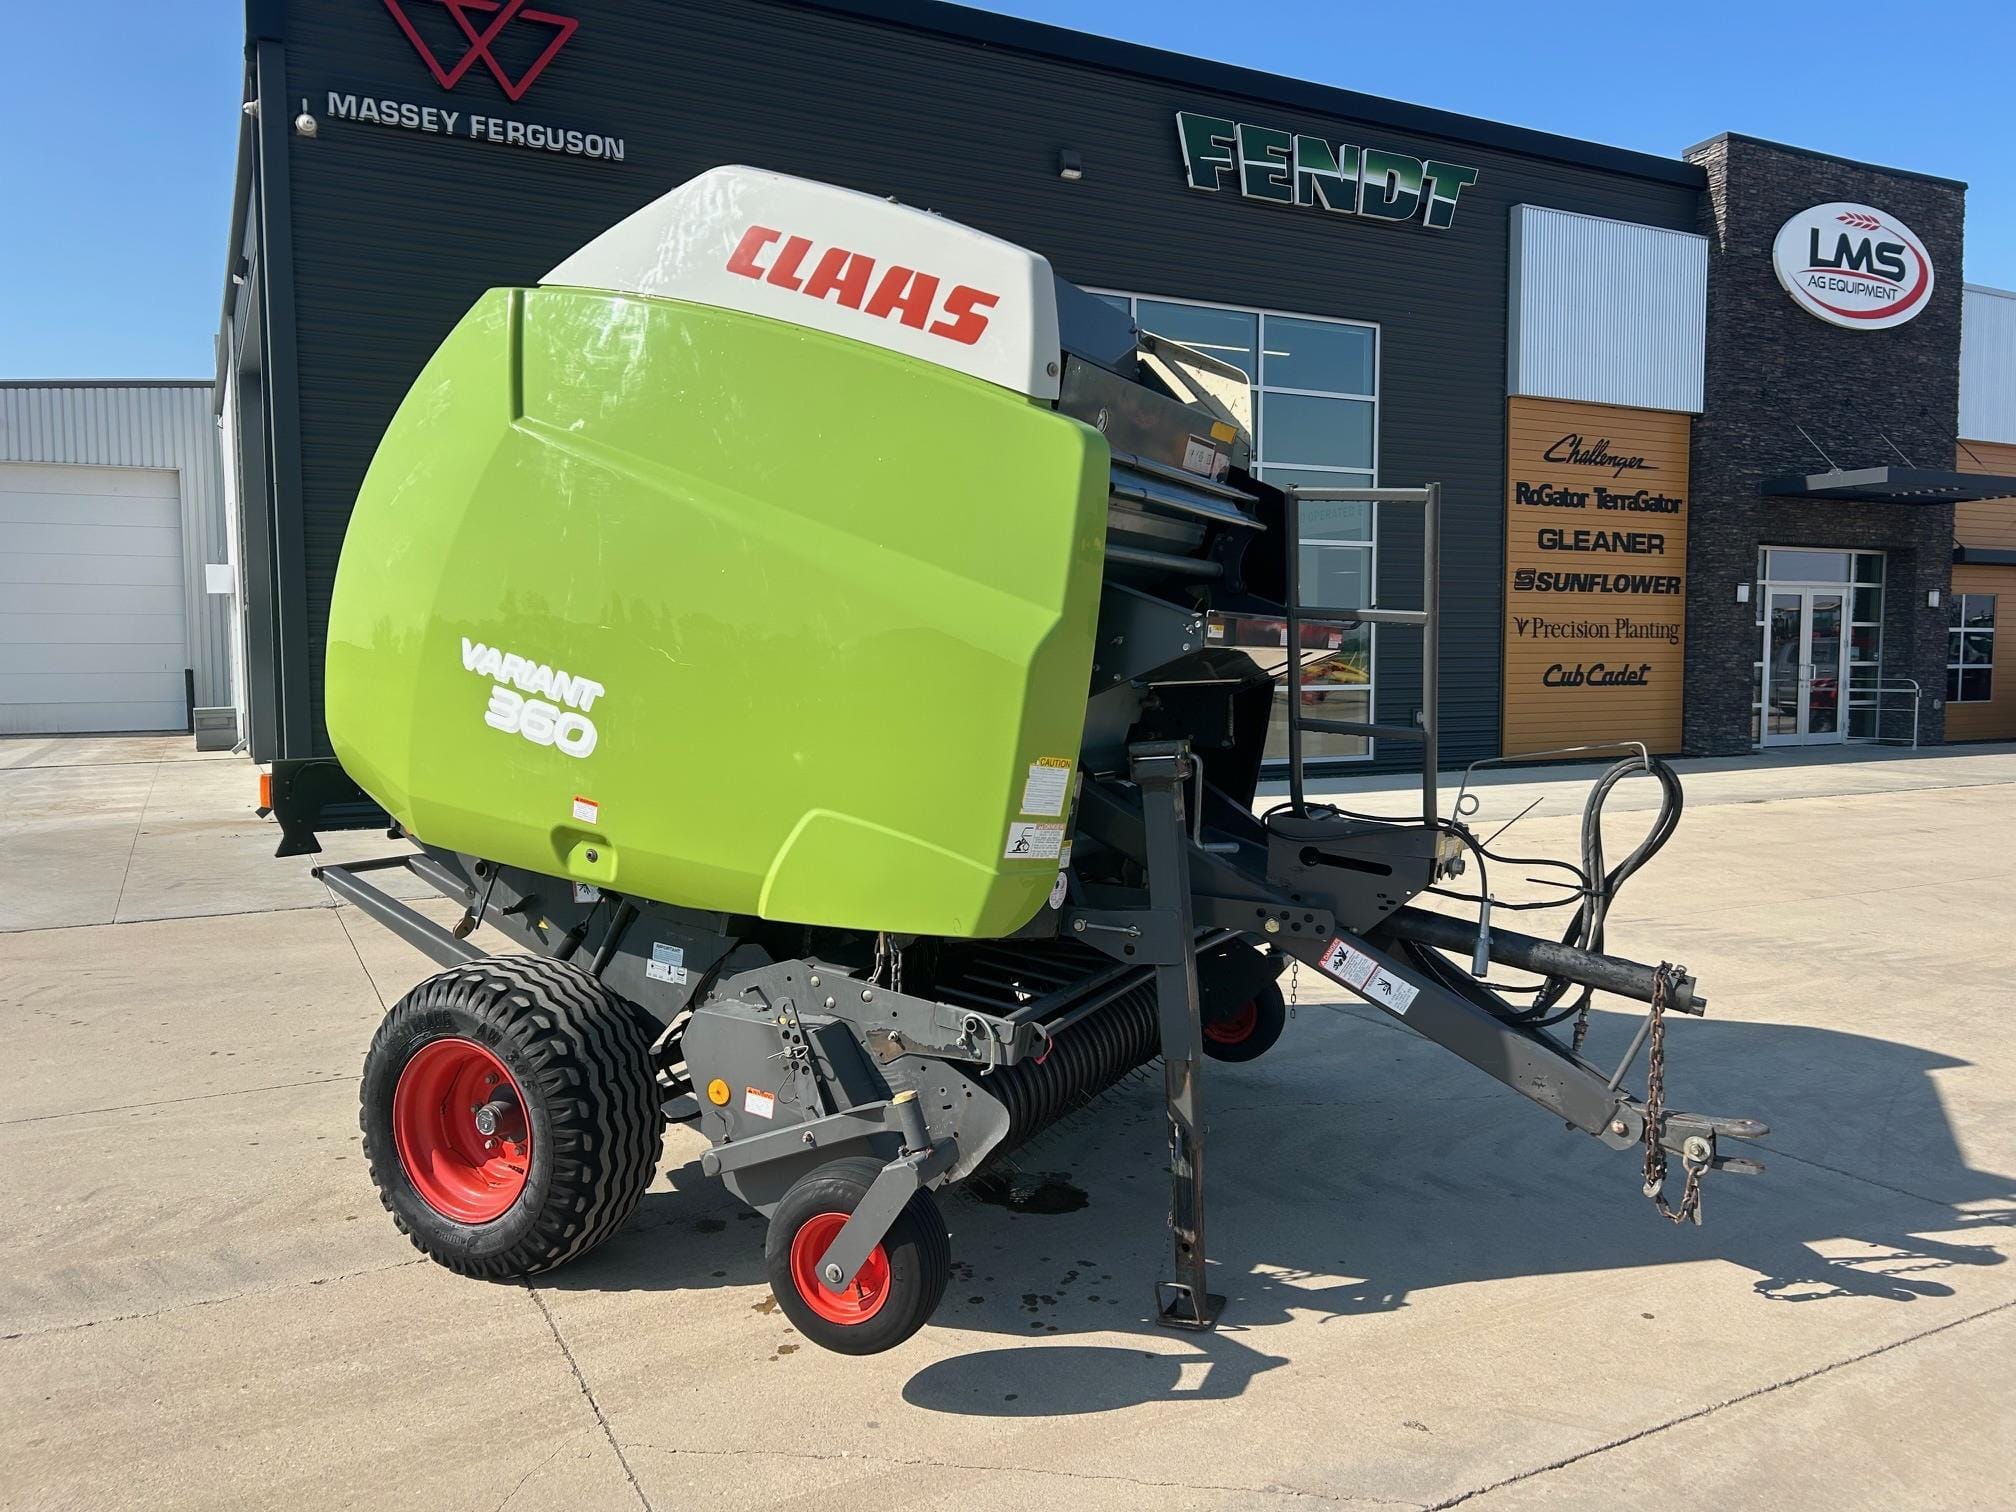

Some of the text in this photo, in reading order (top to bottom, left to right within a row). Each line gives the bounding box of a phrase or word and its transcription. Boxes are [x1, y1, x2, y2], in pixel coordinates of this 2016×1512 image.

[327, 91, 625, 162] MASSEY FERGUSON
[1176, 111, 1479, 230] FENDT
[1809, 227, 1906, 283] LMS
[726, 225, 1000, 346] CLAAS
[1807, 274, 1899, 301] AG EQUIPMENT
[1543, 433, 1661, 479] Challenger
[1515, 481, 1683, 514] RoGator TerraGator
[1537, 528, 1665, 555] GLEANER
[1534, 572, 1682, 595] SUNFLOWER
[1532, 617, 1681, 645] Precision Planting
[461, 637, 606, 713] VARIANT
[1542, 662, 1653, 688] Cub Cadet
[484, 684, 598, 759] 360
[1040, 757, 1070, 769] CAUTION
